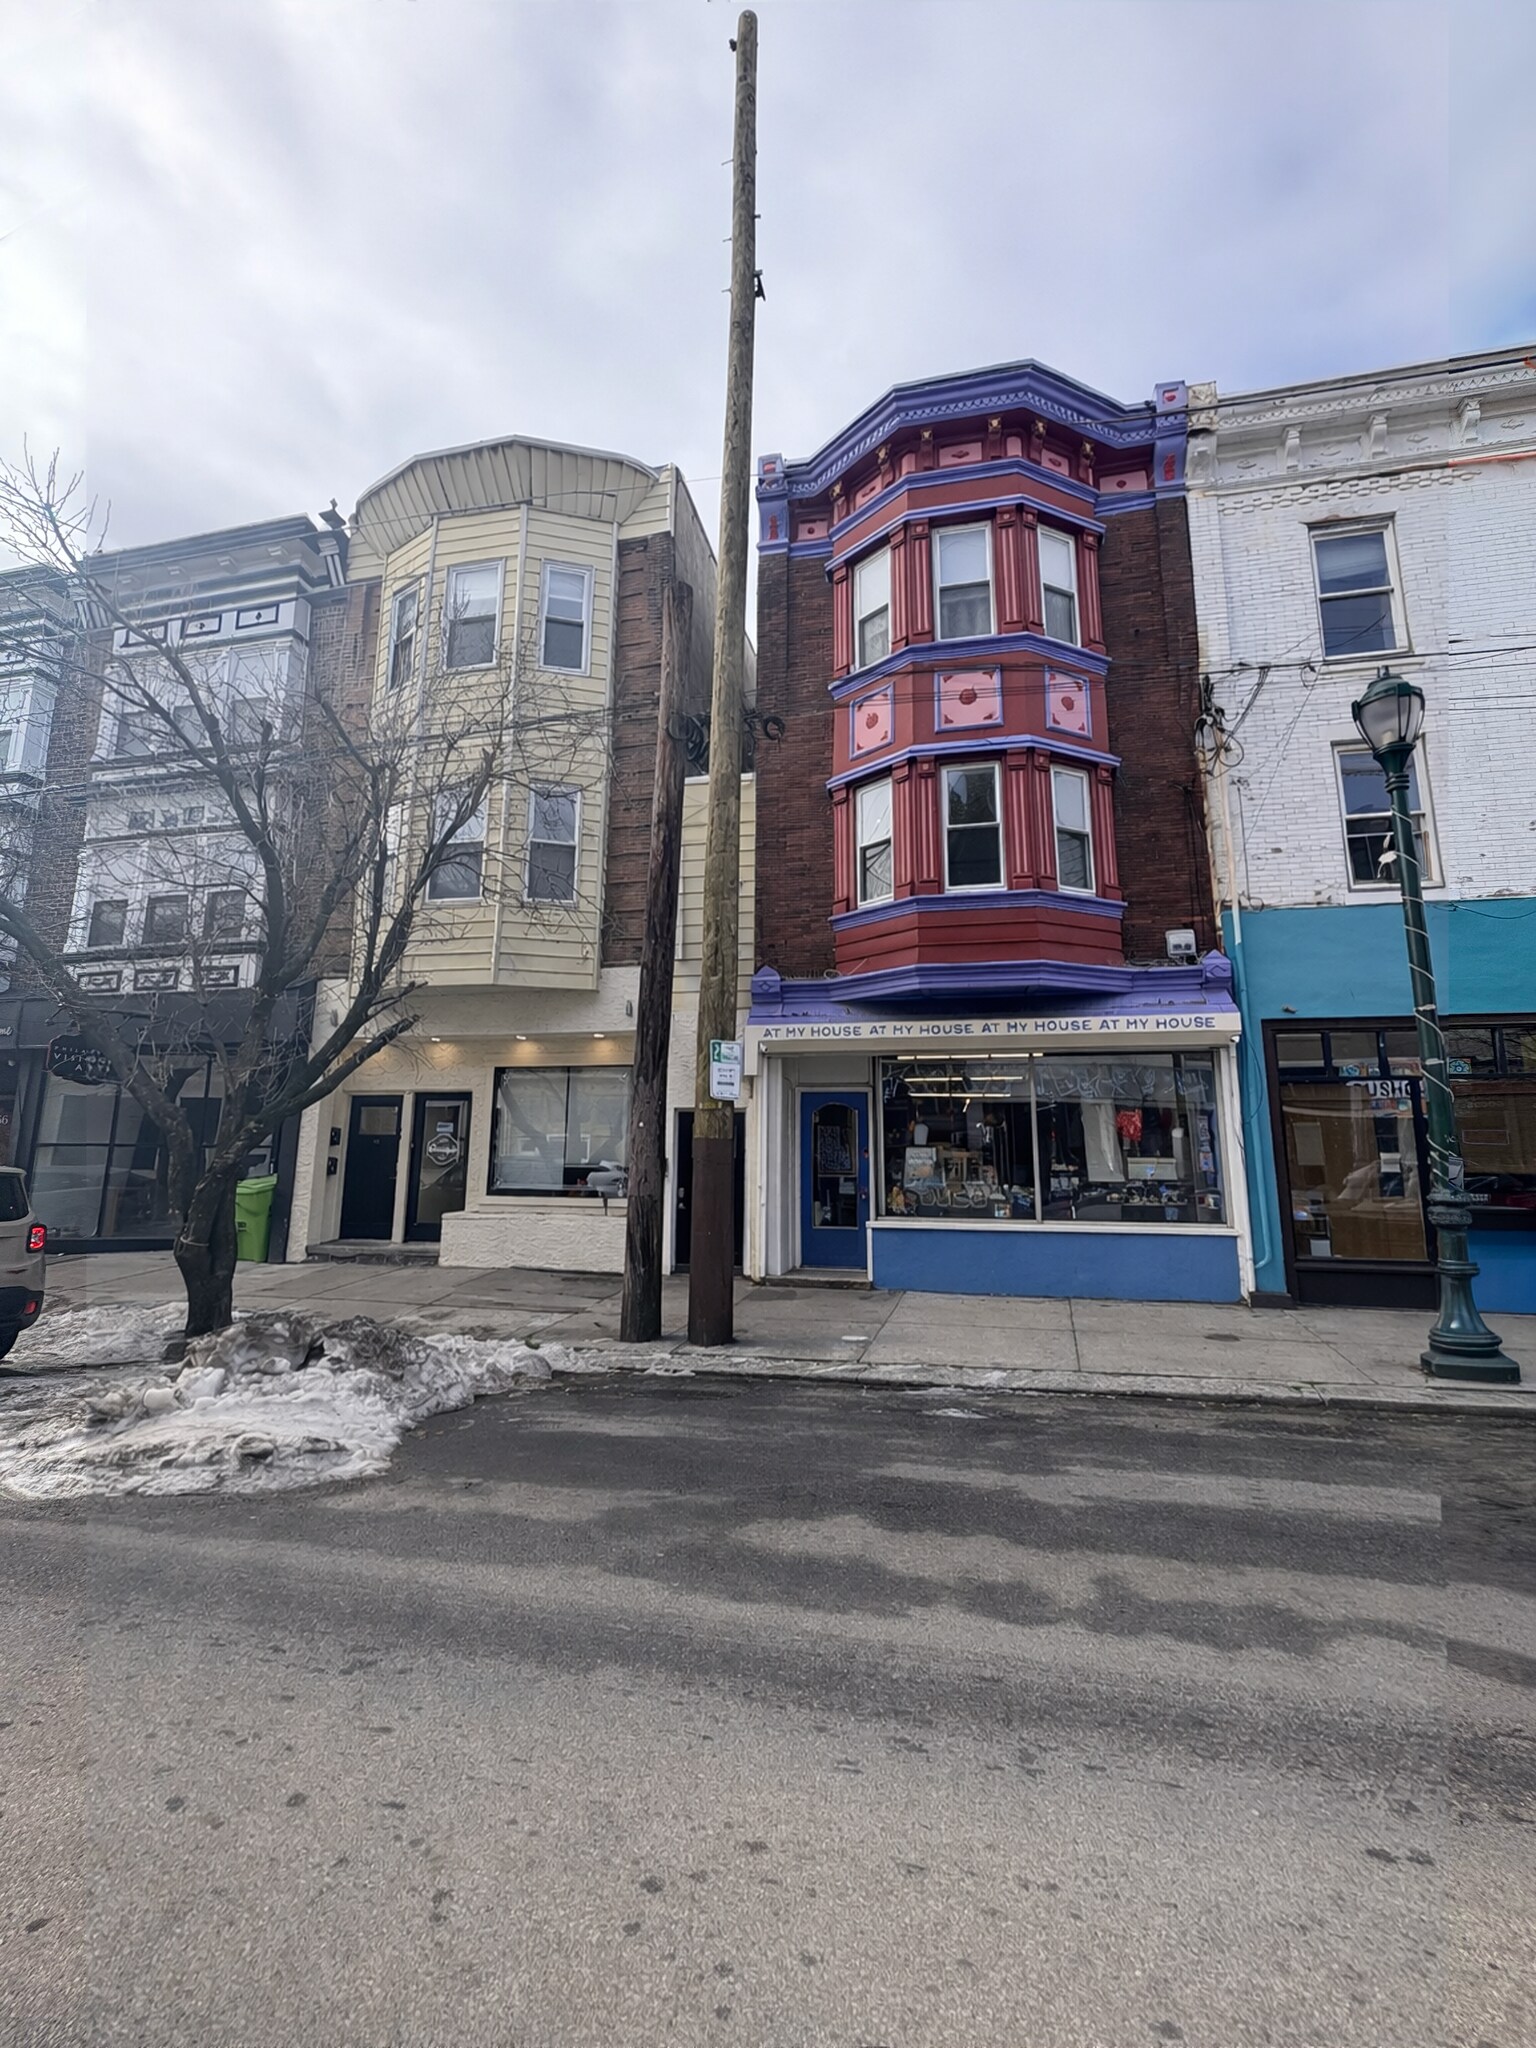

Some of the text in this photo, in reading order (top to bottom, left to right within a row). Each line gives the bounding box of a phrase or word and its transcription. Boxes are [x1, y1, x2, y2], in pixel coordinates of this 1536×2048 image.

[763, 1016, 1216, 1038] AT MY HOUSE AT MY HOUSE AT MY HOUSE AT MY HOUSE
